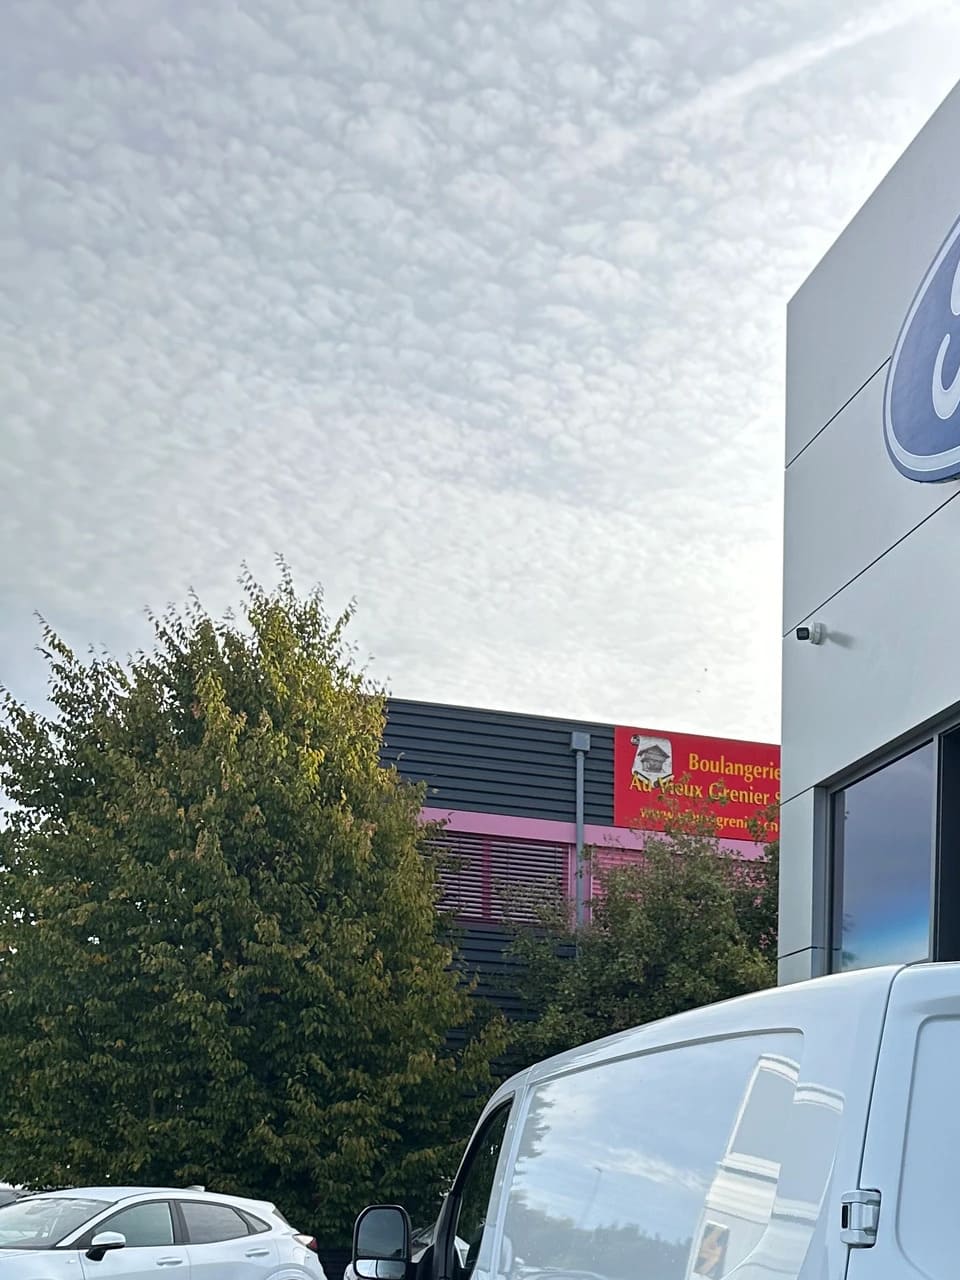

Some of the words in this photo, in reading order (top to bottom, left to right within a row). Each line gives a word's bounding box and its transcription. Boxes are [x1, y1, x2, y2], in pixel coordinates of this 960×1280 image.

[688, 753, 781, 783] Boulangerie
[629, 775, 652, 793] Au
[658, 777, 703, 799] Vieux
[708, 782, 770, 806] Grenier
